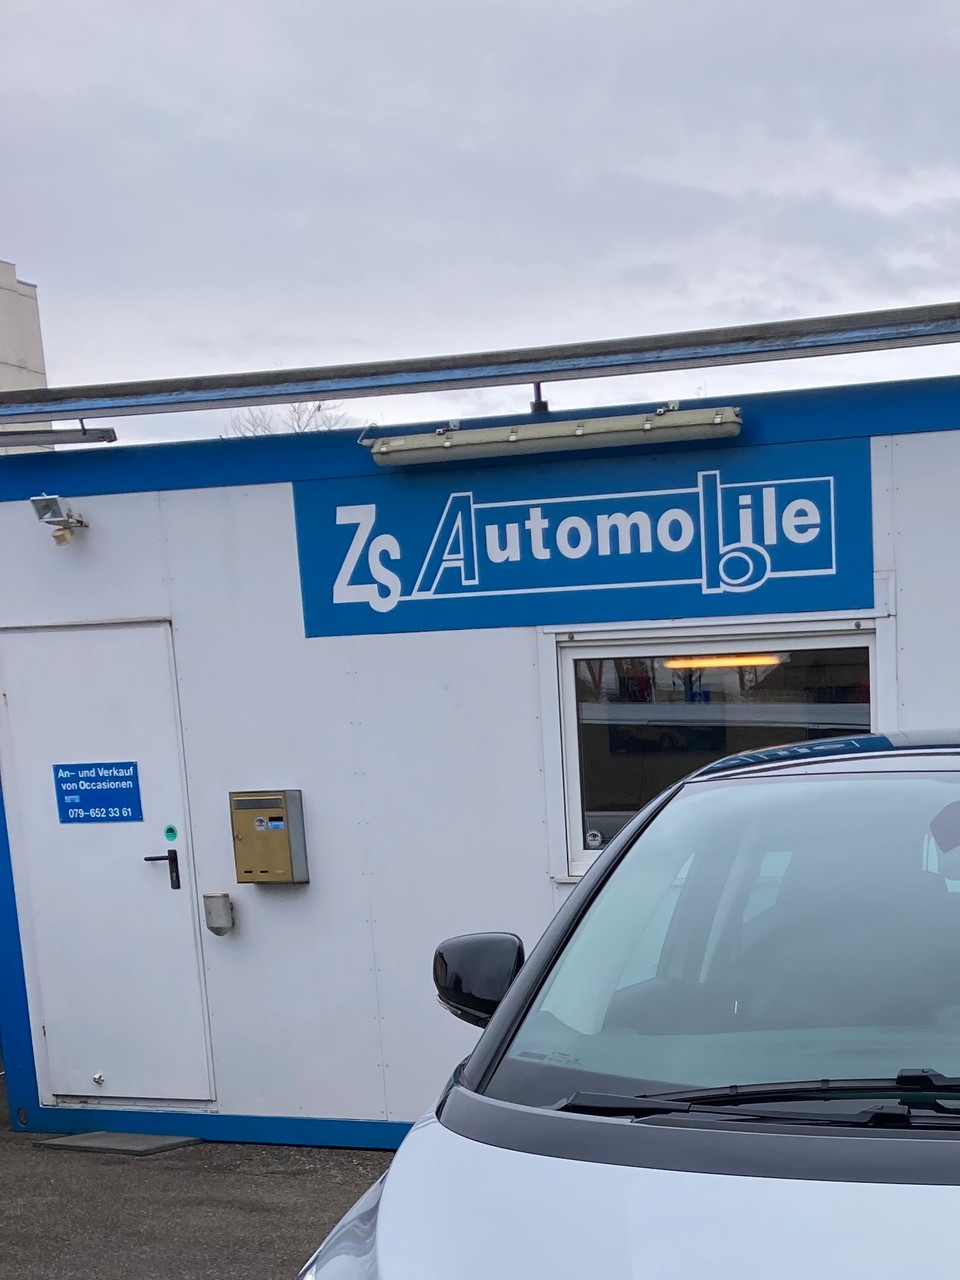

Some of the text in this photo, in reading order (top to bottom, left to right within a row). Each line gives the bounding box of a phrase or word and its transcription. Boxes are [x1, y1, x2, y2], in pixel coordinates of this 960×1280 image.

[333, 470, 823, 612] Zs Automobile
[78, 768, 96, 777] und
[97, 766, 134, 777] Verkauf
[61, 779, 133, 790] von Occasionen
[108, 807, 120, 817] 33
[121, 807, 132, 817] 61
